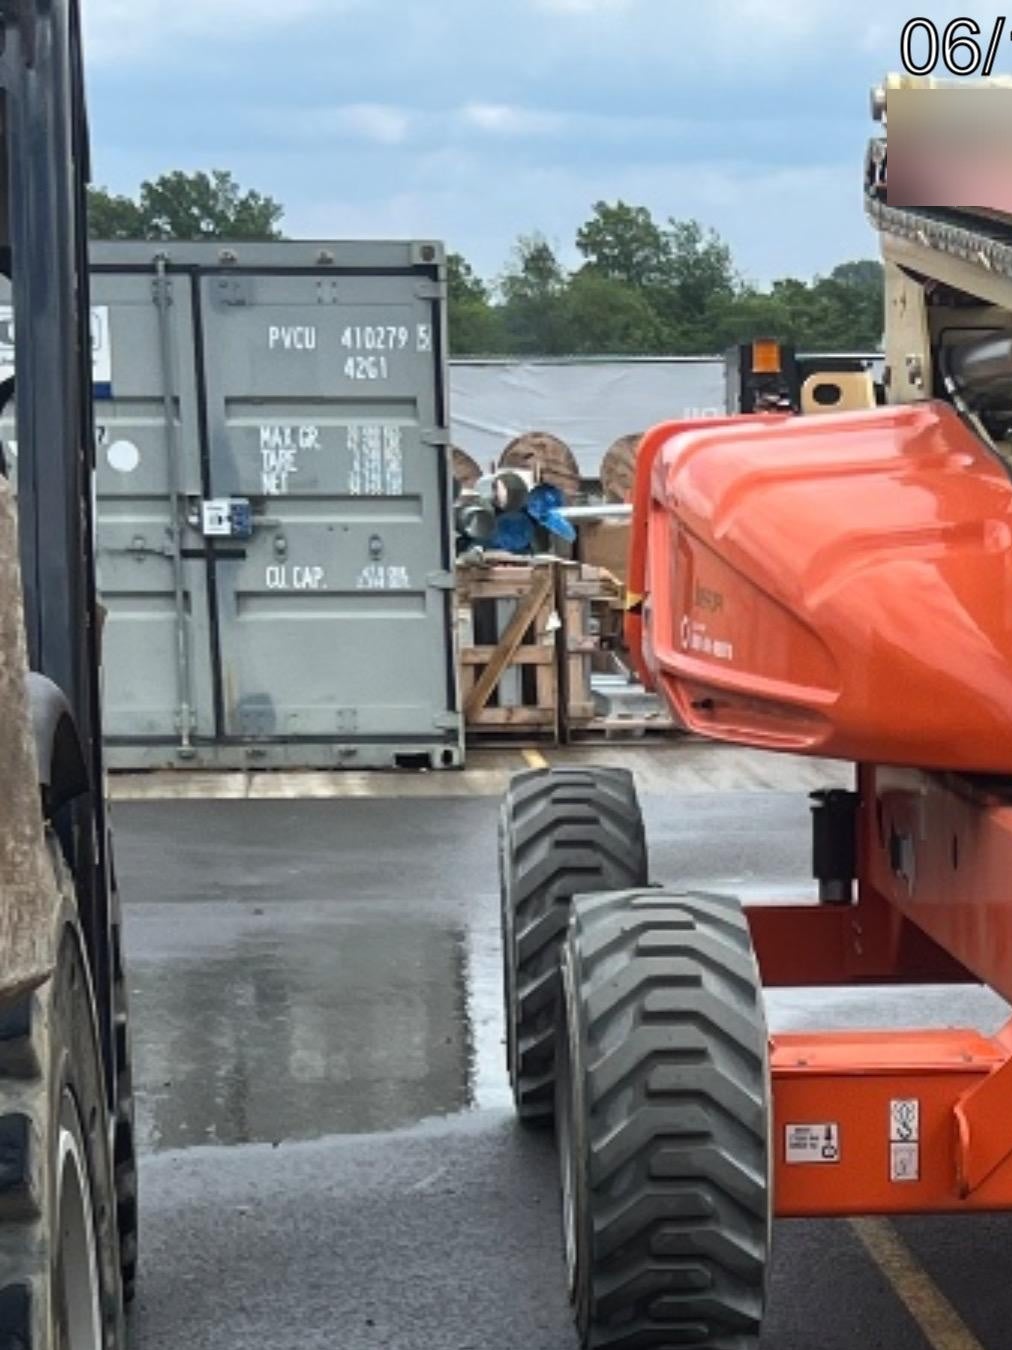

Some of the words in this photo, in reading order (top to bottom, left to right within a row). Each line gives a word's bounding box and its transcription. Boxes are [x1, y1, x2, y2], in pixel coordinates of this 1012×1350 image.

[268, 326, 316, 349] PVCU
[341, 326, 409, 349] 410279
[416, 324, 432, 351] 5
[293, 565, 327, 588] CAP.
